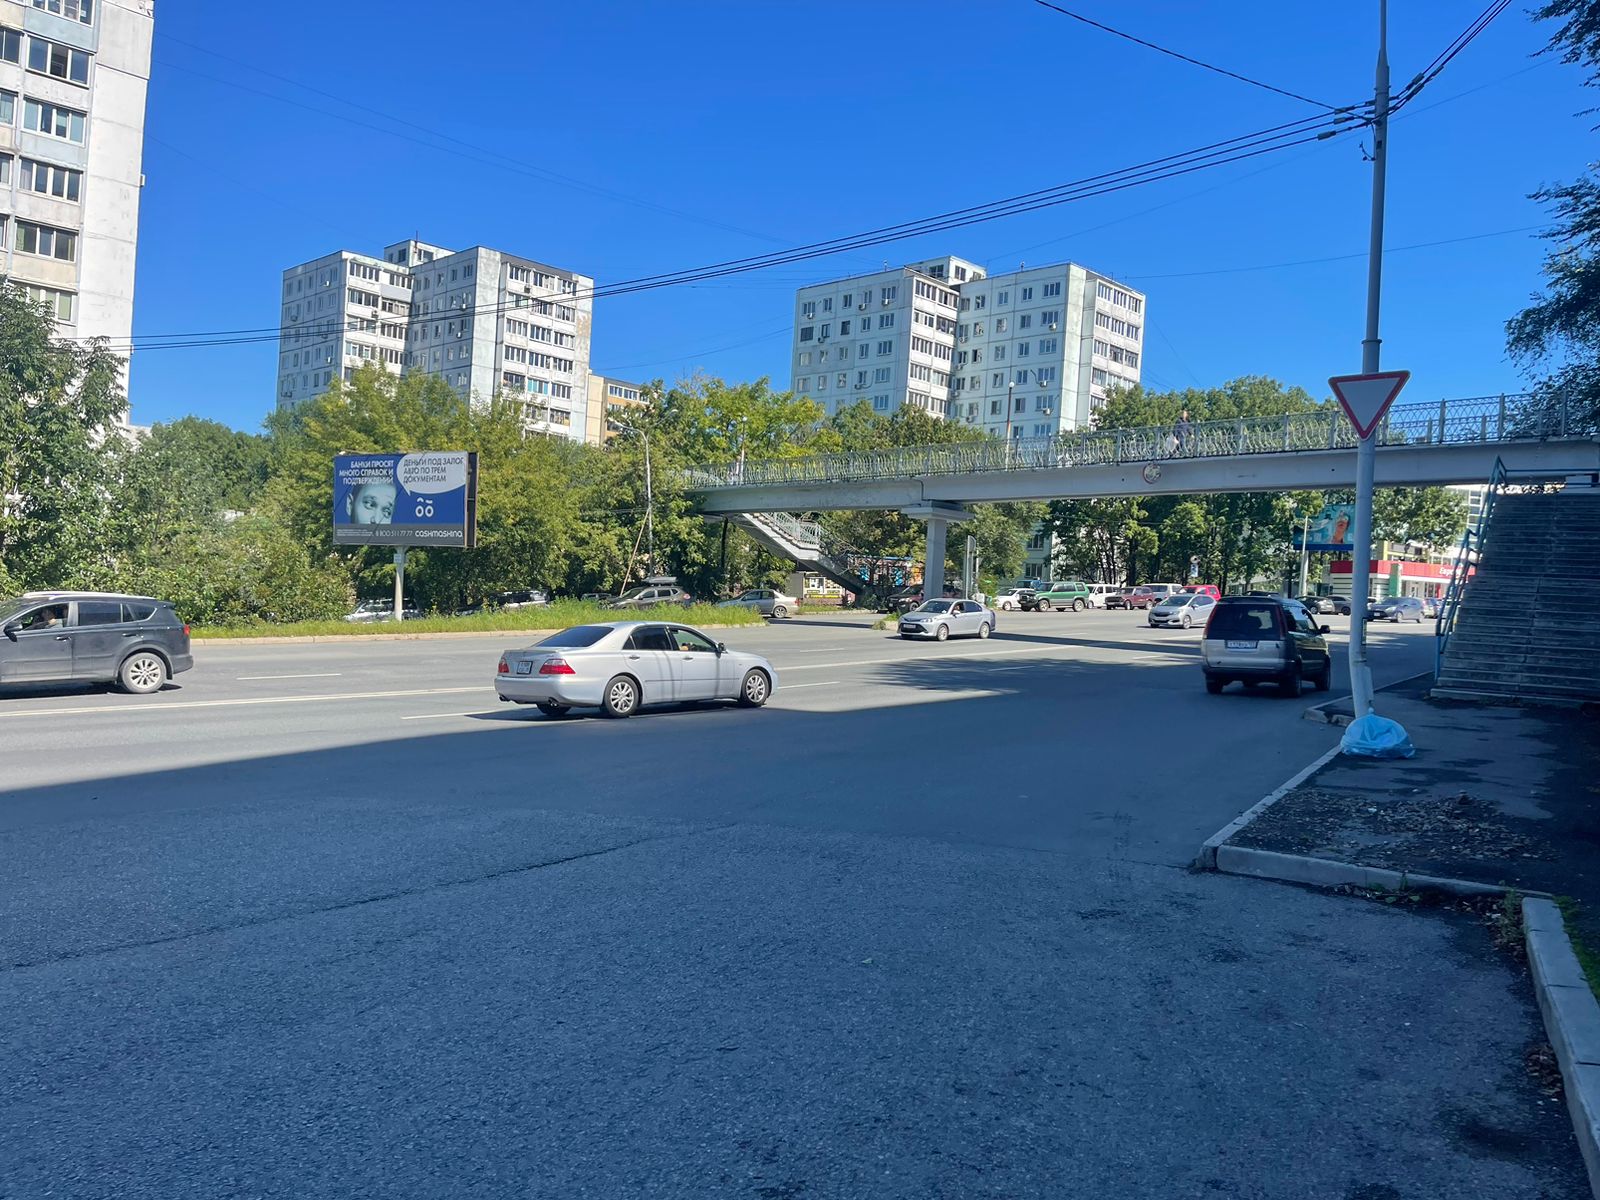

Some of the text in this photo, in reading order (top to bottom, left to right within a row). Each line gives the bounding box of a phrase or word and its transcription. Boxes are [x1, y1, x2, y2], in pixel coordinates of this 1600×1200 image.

[371, 460, 395, 468] ПРОСЯТ
[403, 457, 464, 467] ДЕНЬГИ ПОД ЗАЛОГ
[339, 469, 360, 477] МНОГО
[360, 468, 388, 476] СПРАВОК
[431, 466, 447, 474] ТРЕМ
[403, 475, 447, 484] ДОКУМЕНТАМ
